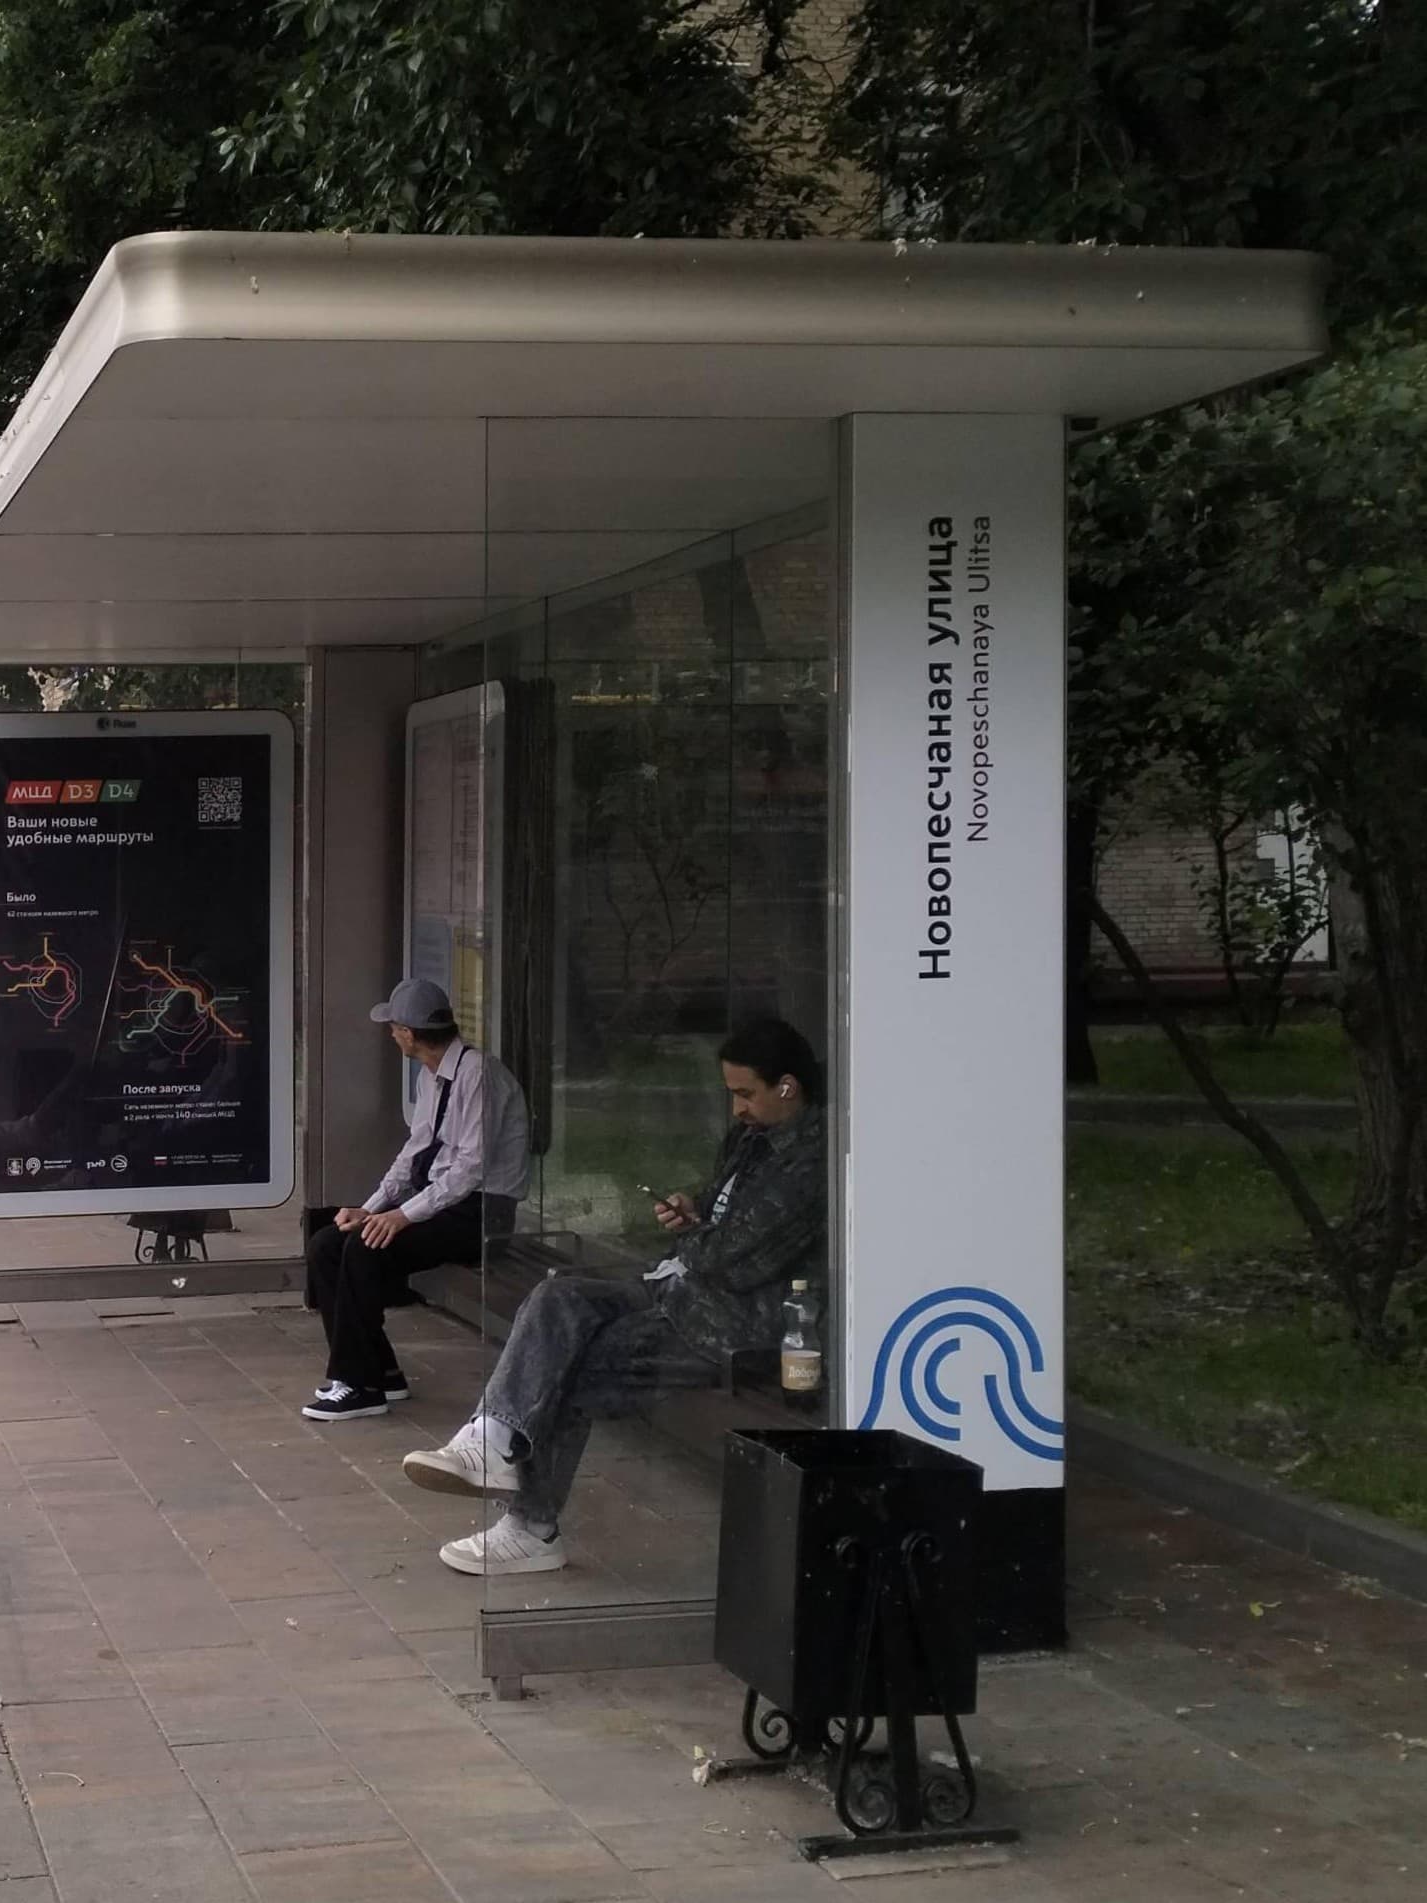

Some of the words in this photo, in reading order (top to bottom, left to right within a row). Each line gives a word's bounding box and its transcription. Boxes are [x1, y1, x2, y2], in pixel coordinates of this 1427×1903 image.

[966, 515, 992, 592] Ulitsa
[928, 515, 960, 646] улица
[966, 603, 995, 843] Novopeschanaya
[12, 785, 53, 799] МЦД
[67, 783, 94, 799] D3
[107, 783, 135, 798] D4
[6, 815, 47, 829] Ваши
[51, 816, 99, 828] новые
[918, 662, 953, 980] Новопесчаная
[6, 831, 73, 848] удобные
[75, 831, 154, 846] маршруты
[6, 891, 37, 903] Было
[122, 1084, 157, 1095] После
[158, 1083, 202, 1096] запуска
[175, 1110, 191, 1119] 140
